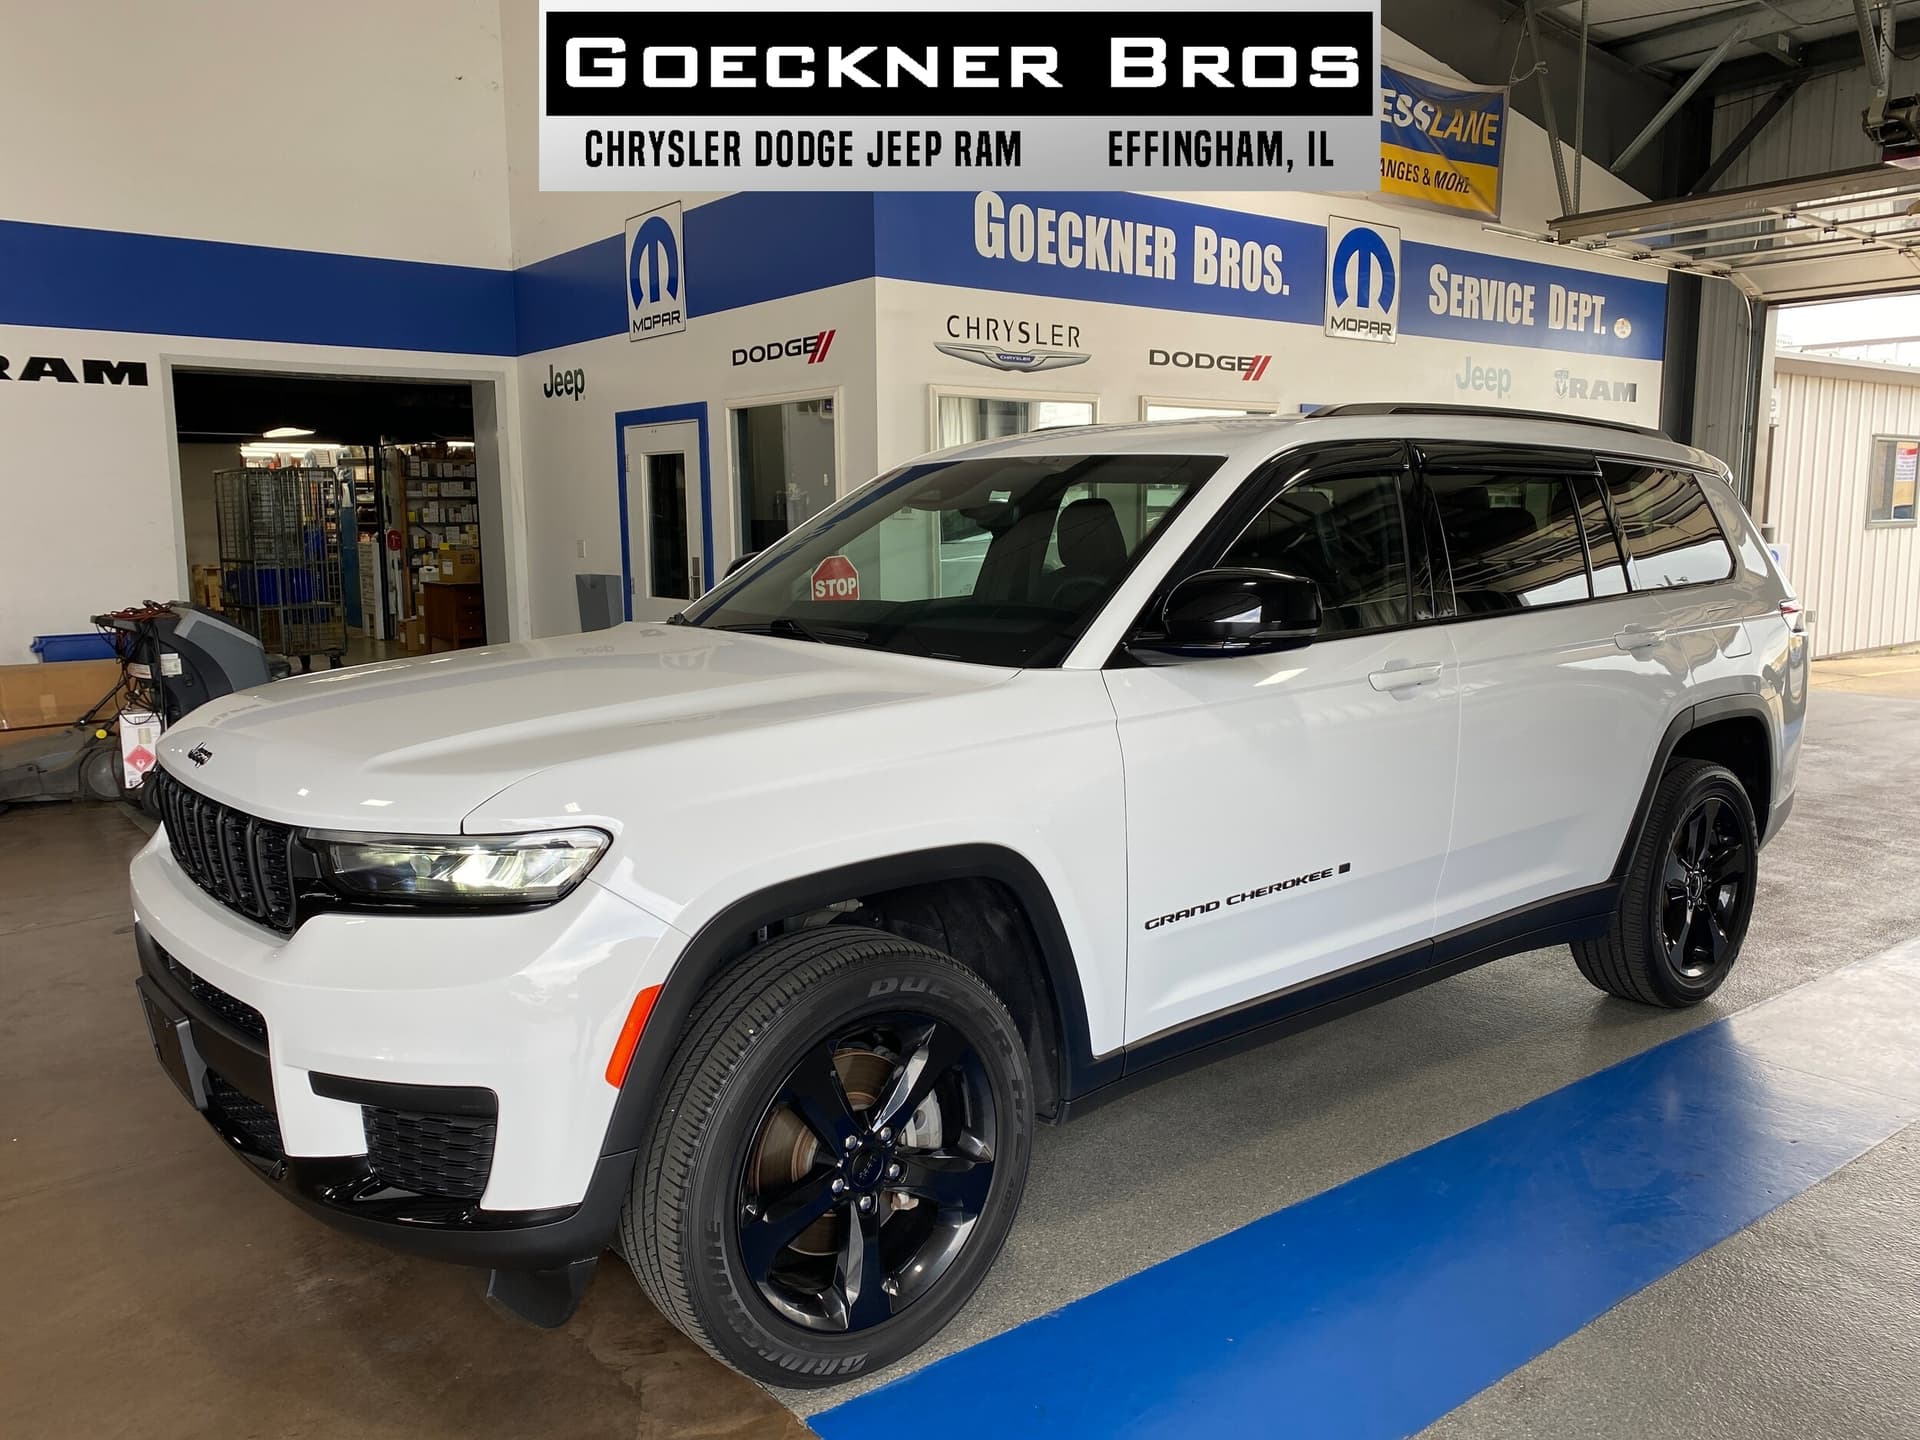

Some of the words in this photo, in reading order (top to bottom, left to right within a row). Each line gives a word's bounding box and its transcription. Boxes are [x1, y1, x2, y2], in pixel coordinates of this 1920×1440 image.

[974, 191, 1176, 280] GOECKNER
[1193, 225, 1289, 296] BROS.
[1429, 264, 1535, 326] SERVICE
[1548, 284, 1606, 335] DEPT.
[632, 310, 681, 333] MOPAR
[947, 315, 1080, 348] CHRYSLER
[1330, 316, 1392, 336] MOPAR
[732, 335, 822, 366] DODGE
[1150, 349, 1256, 373] DODGE
[0, 355, 148, 386] AM
[544, 364, 584, 401] Jeep
[1455, 356, 1512, 399] Jeep
[1569, 377, 1637, 402] RAM
[815, 577, 856, 597] STOP
[1144, 900, 1220, 930] GRAND
[1226, 868, 1333, 906] CHEROKEE
